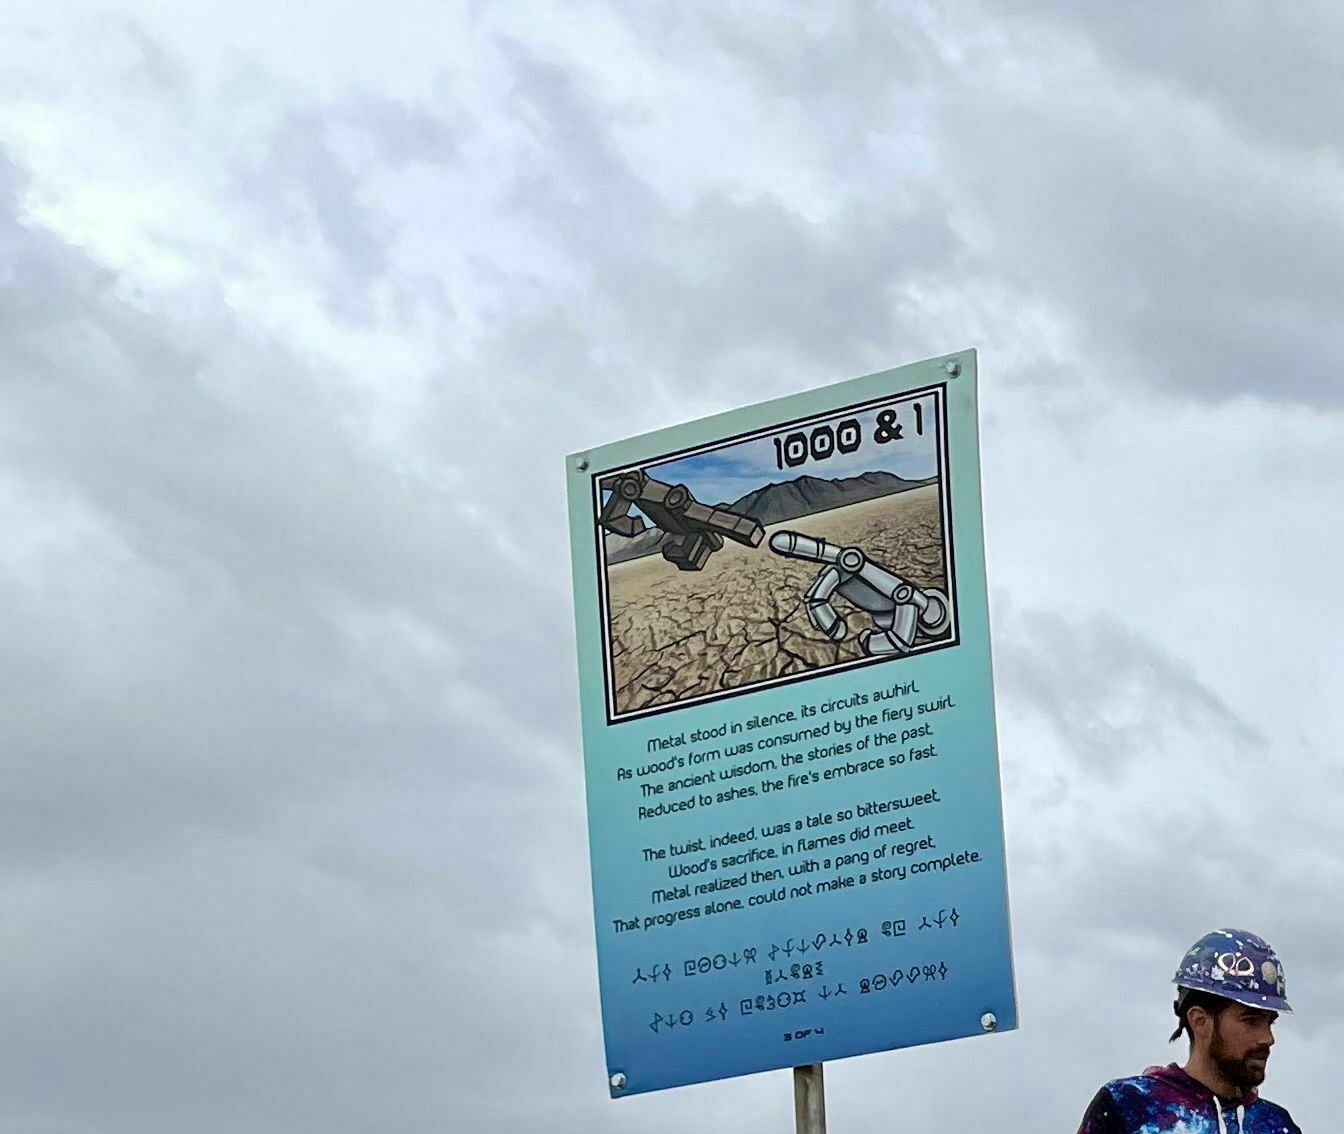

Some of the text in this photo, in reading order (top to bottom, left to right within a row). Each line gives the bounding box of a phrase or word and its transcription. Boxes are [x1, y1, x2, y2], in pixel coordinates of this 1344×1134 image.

[773, 402, 923, 470] 1000 & 1
[617, 767, 633, 782] As
[636, 755, 685, 777] wood's
[688, 750, 721, 766] form
[724, 742, 754, 757] was
[757, 721, 830, 750] consumed
[833, 719, 852, 735] by
[854, 714, 878, 728] the
[882, 706, 913, 723] fiery
[647, 732, 687, 754] Metal
[690, 722, 727, 744] stood
[730, 720, 743, 734] in
[800, 704, 817, 719] its
[820, 692, 869, 714] circuits
[638, 795, 696, 821] Reduced
[698, 794, 713, 807] to
[761, 779, 784, 793] the
[787, 770, 820, 789] fire's
[823, 758, 885, 780] embrace
[888, 753, 906, 766] so
[640, 783, 664, 798] The
[668, 769, 716, 792] ancient
[780, 752, 804, 767] the
[807, 742, 853, 762] stories
[856, 734, 870, 750] of
[874, 732, 898, 747] the
[641, 848, 666, 862] The
[761, 822, 791, 838] was
[794, 820, 803, 831] a
[806, 812, 833, 828] tale
[836, 810, 853, 822] so
[668, 858, 718, 879] Wood's
[781, 842, 794, 856] in
[797, 833, 846, 853] flames
[849, 825, 870, 842] did
[612, 916, 641, 933] That
[644, 907, 701, 931] progress
[748, 886, 786, 907] could
[790, 881, 813, 899] not
[816, 875, 855, 894] make
[859, 874, 867, 885] a
[871, 866, 906, 882] story
[910, 850, 984, 874] complete.
[652, 884, 692, 904] Metal
[694, 872, 748, 896] realized
[788, 858, 820, 876] with
[823, 858, 831, 869] a
[835, 851, 870, 871] pang
[873, 843, 887, 859] of
[795, 1029, 811, 1040] OF
